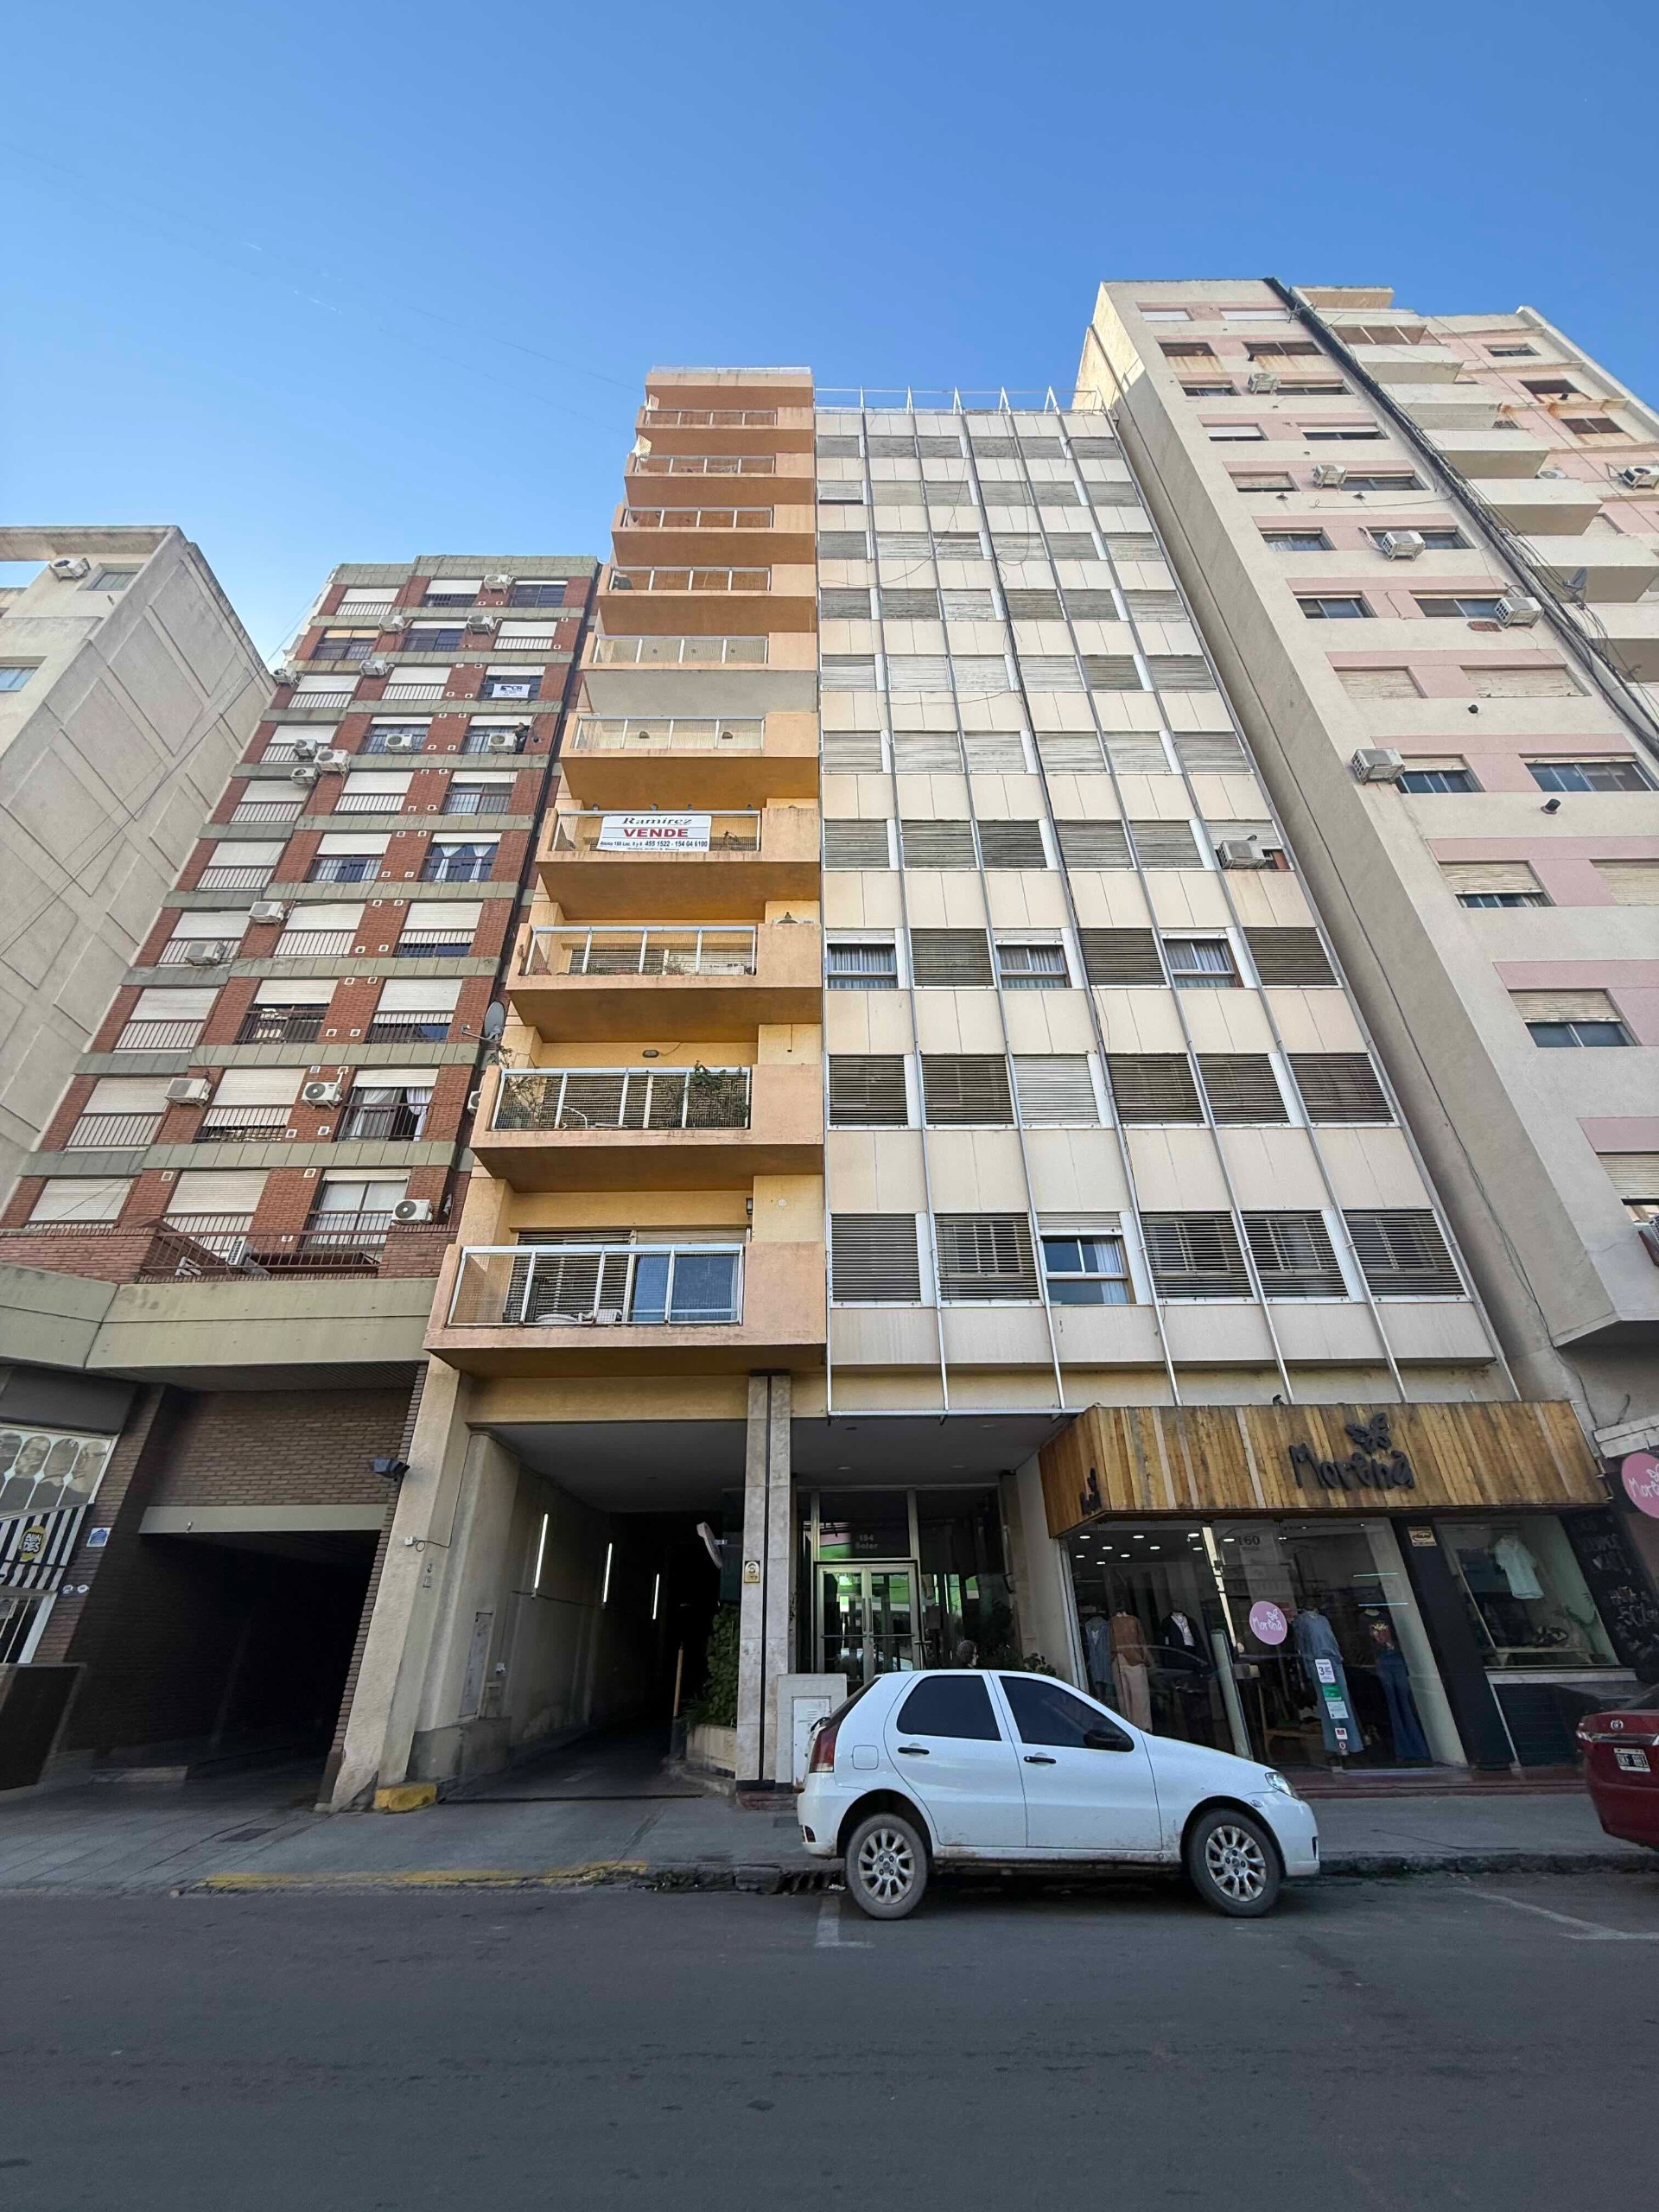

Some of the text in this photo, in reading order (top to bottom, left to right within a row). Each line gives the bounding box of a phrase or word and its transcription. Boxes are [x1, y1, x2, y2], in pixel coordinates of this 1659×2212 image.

[623, 829, 689, 837] VENDE
[1237, 1535, 1261, 1546] 160
[23, 1541, 41, 1553] DES
[1318, 1666, 1325, 1675] 3
